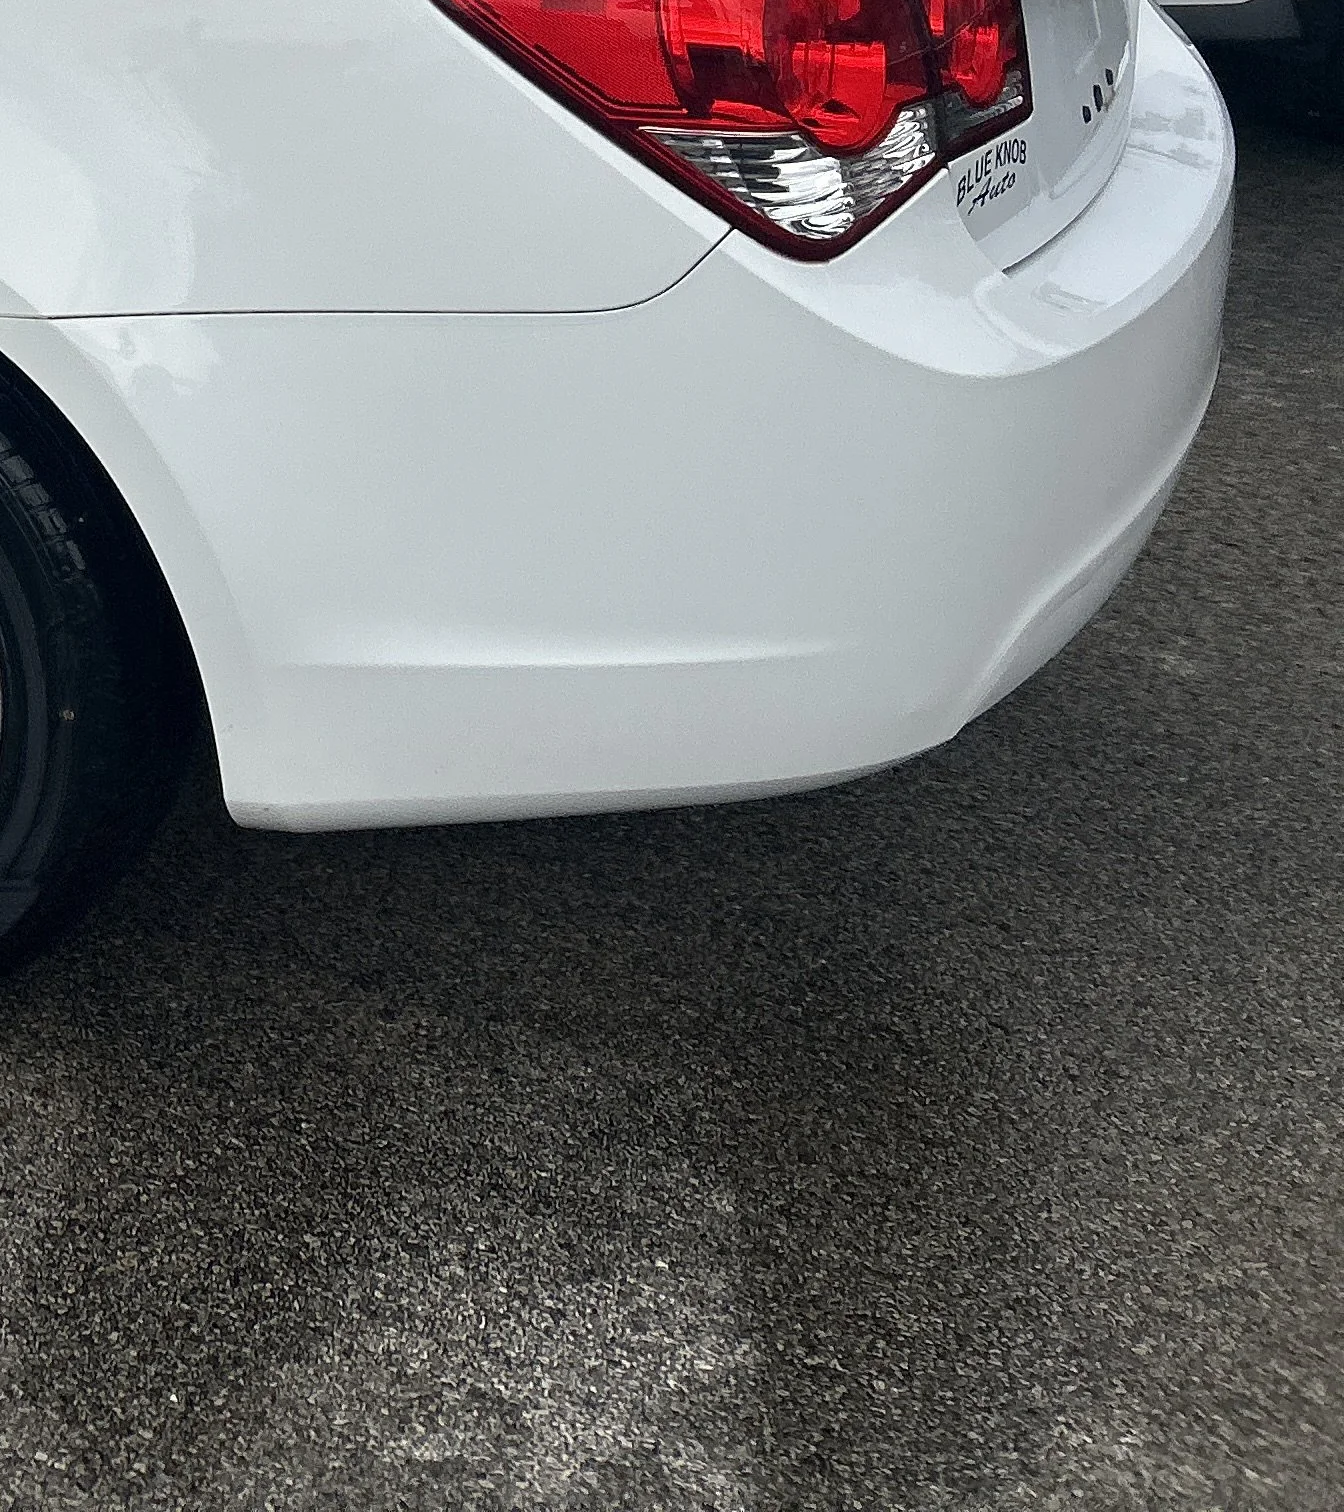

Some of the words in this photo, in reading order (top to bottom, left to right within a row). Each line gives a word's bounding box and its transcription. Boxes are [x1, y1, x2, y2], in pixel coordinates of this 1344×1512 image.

[956, 149, 993, 207] BLUE
[995, 138, 1027, 169] KNOB
[967, 171, 1016, 216] Auto
